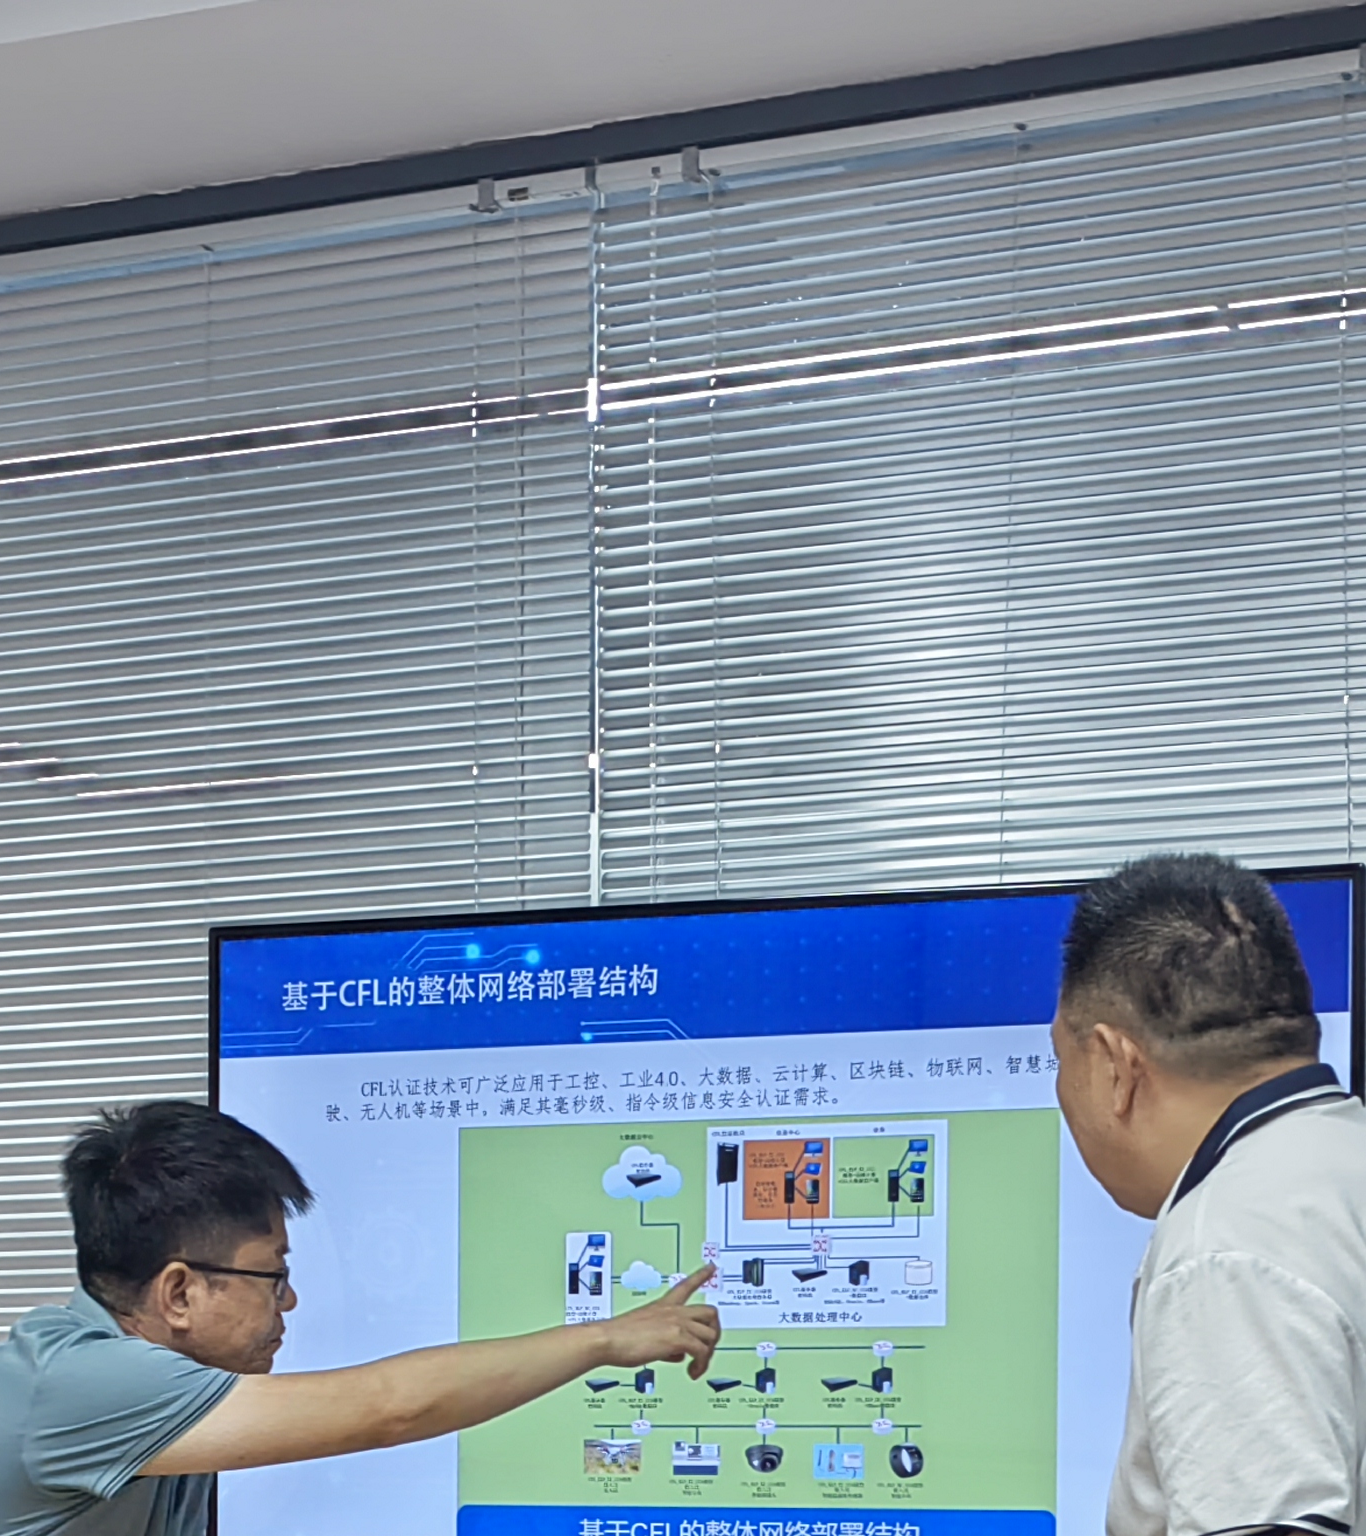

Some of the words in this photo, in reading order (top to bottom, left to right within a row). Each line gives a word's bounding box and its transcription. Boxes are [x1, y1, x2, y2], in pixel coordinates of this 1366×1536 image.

[281, 963, 659, 1012] 基于CFL的整体网络部署结构
[778, 1311, 863, 1324] 大数据处理中心
